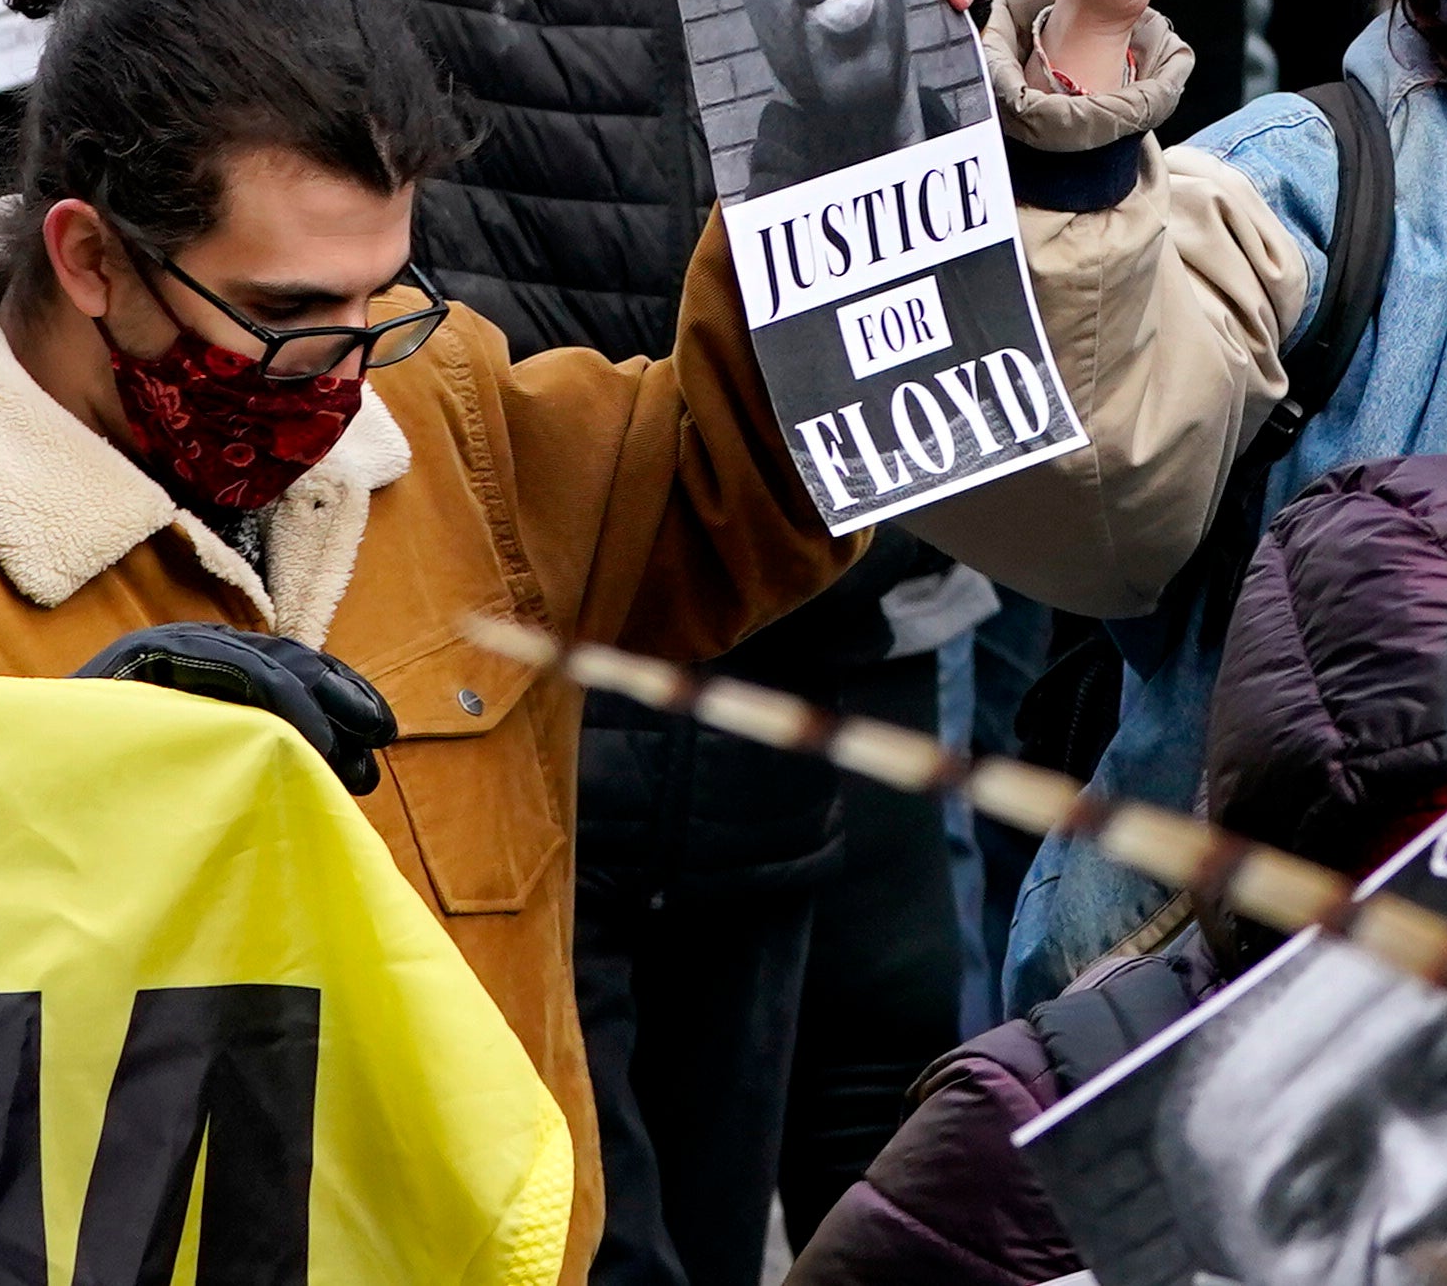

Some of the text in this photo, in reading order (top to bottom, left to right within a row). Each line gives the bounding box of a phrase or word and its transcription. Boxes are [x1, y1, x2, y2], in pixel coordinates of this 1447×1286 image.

[756, 155, 990, 321] JUSTICE
[857, 295, 934, 365] FOR
[796, 345, 1053, 513] FLOYD
